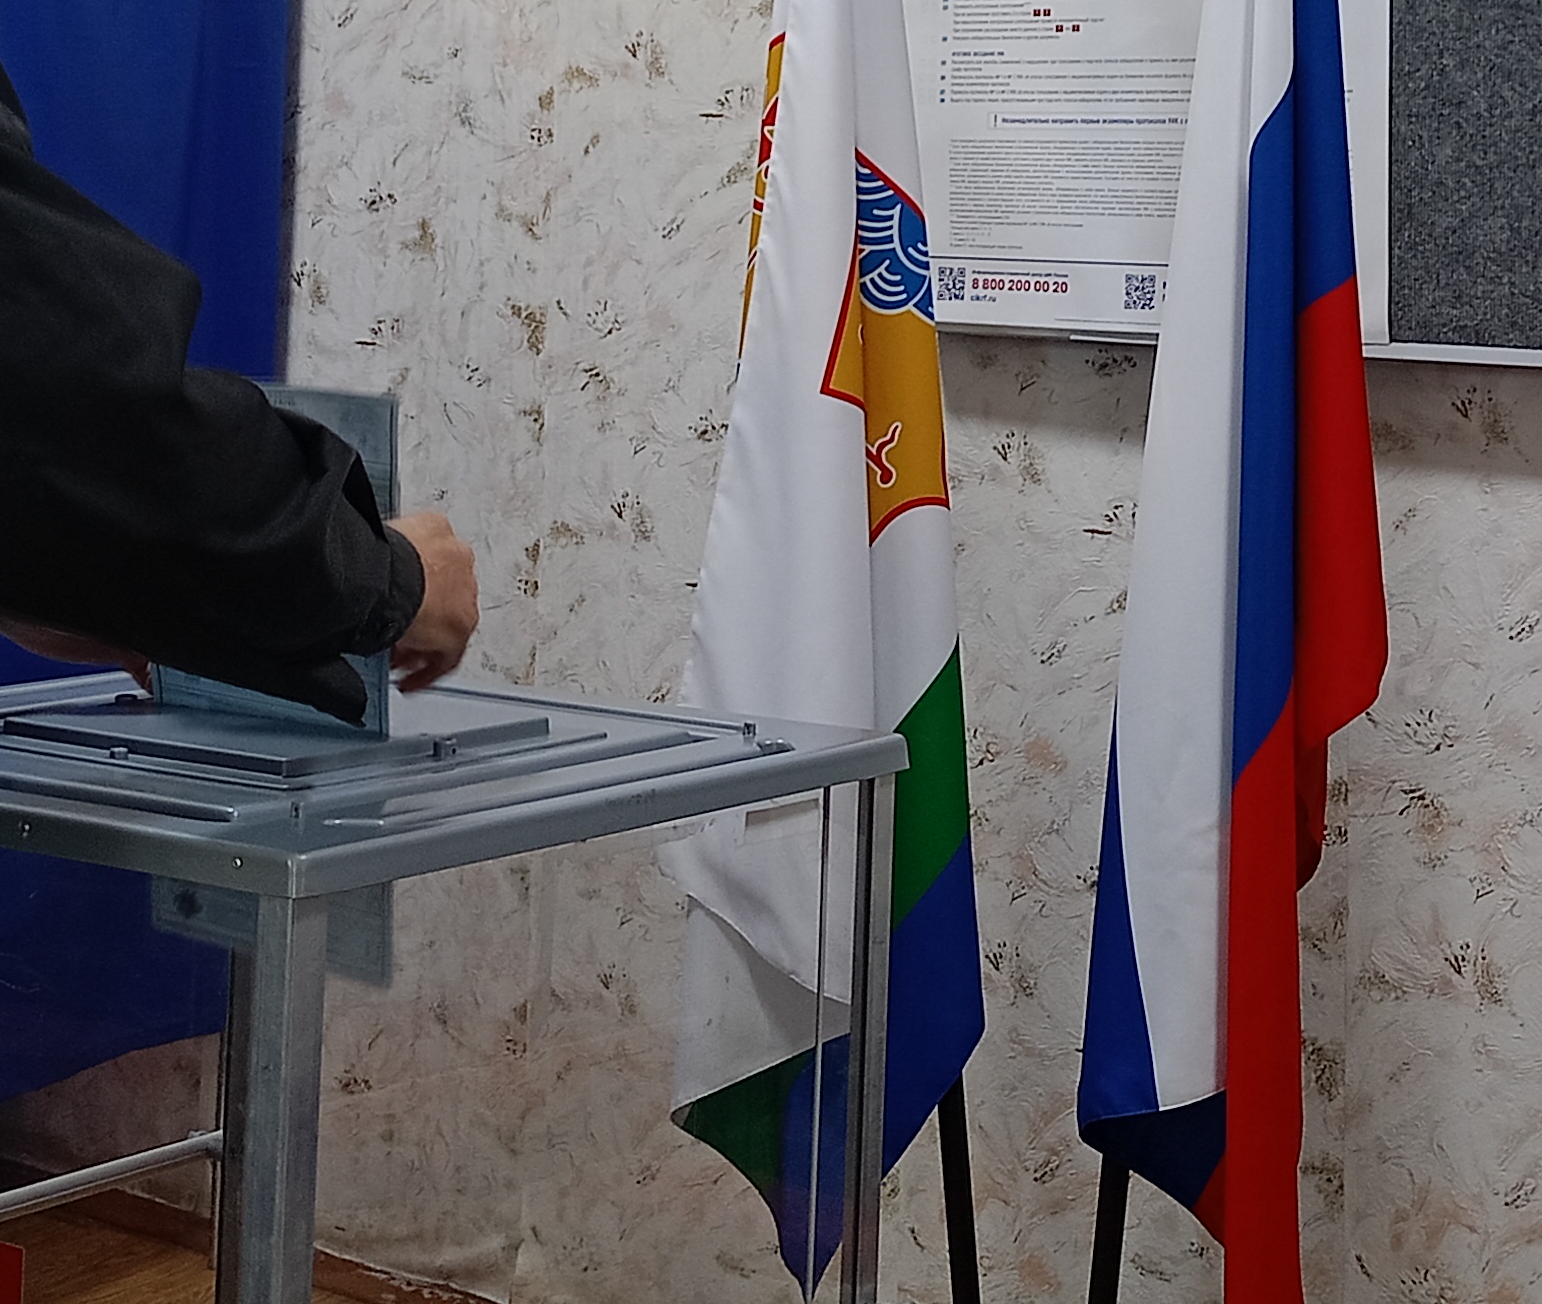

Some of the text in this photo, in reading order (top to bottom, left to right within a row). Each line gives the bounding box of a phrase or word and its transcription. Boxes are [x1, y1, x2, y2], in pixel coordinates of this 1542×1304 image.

[972, 278, 1068, 293] 8 800 200 00 20
